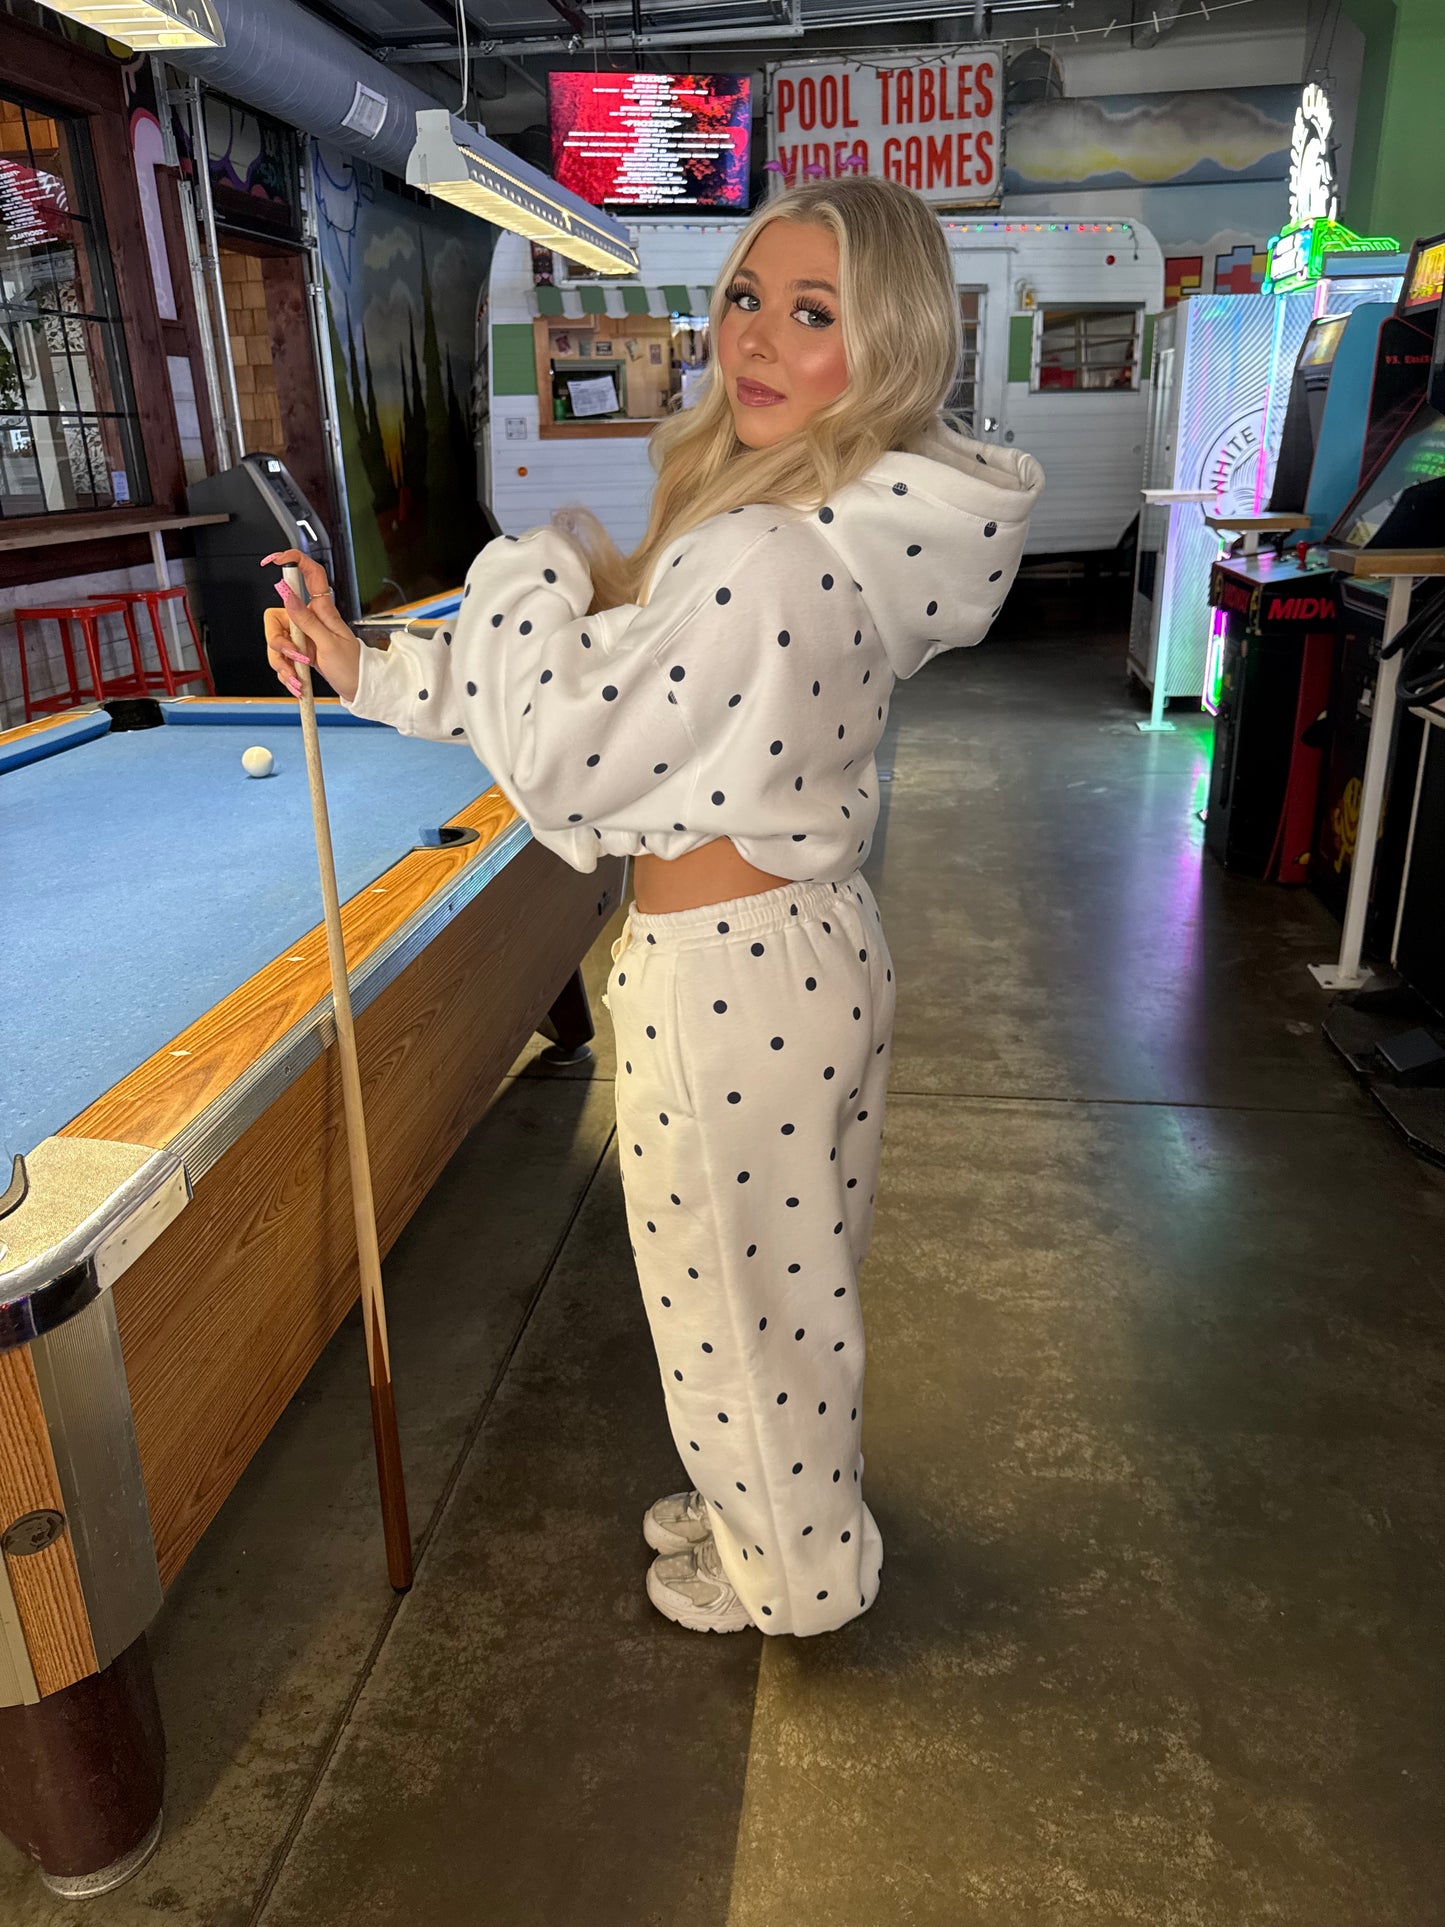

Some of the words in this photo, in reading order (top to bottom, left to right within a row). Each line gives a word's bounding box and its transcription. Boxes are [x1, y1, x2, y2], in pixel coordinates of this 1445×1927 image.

[777, 74, 859, 133] POOL
[876, 62, 994, 126] TABLES
[883, 130, 993, 190] GAMES
